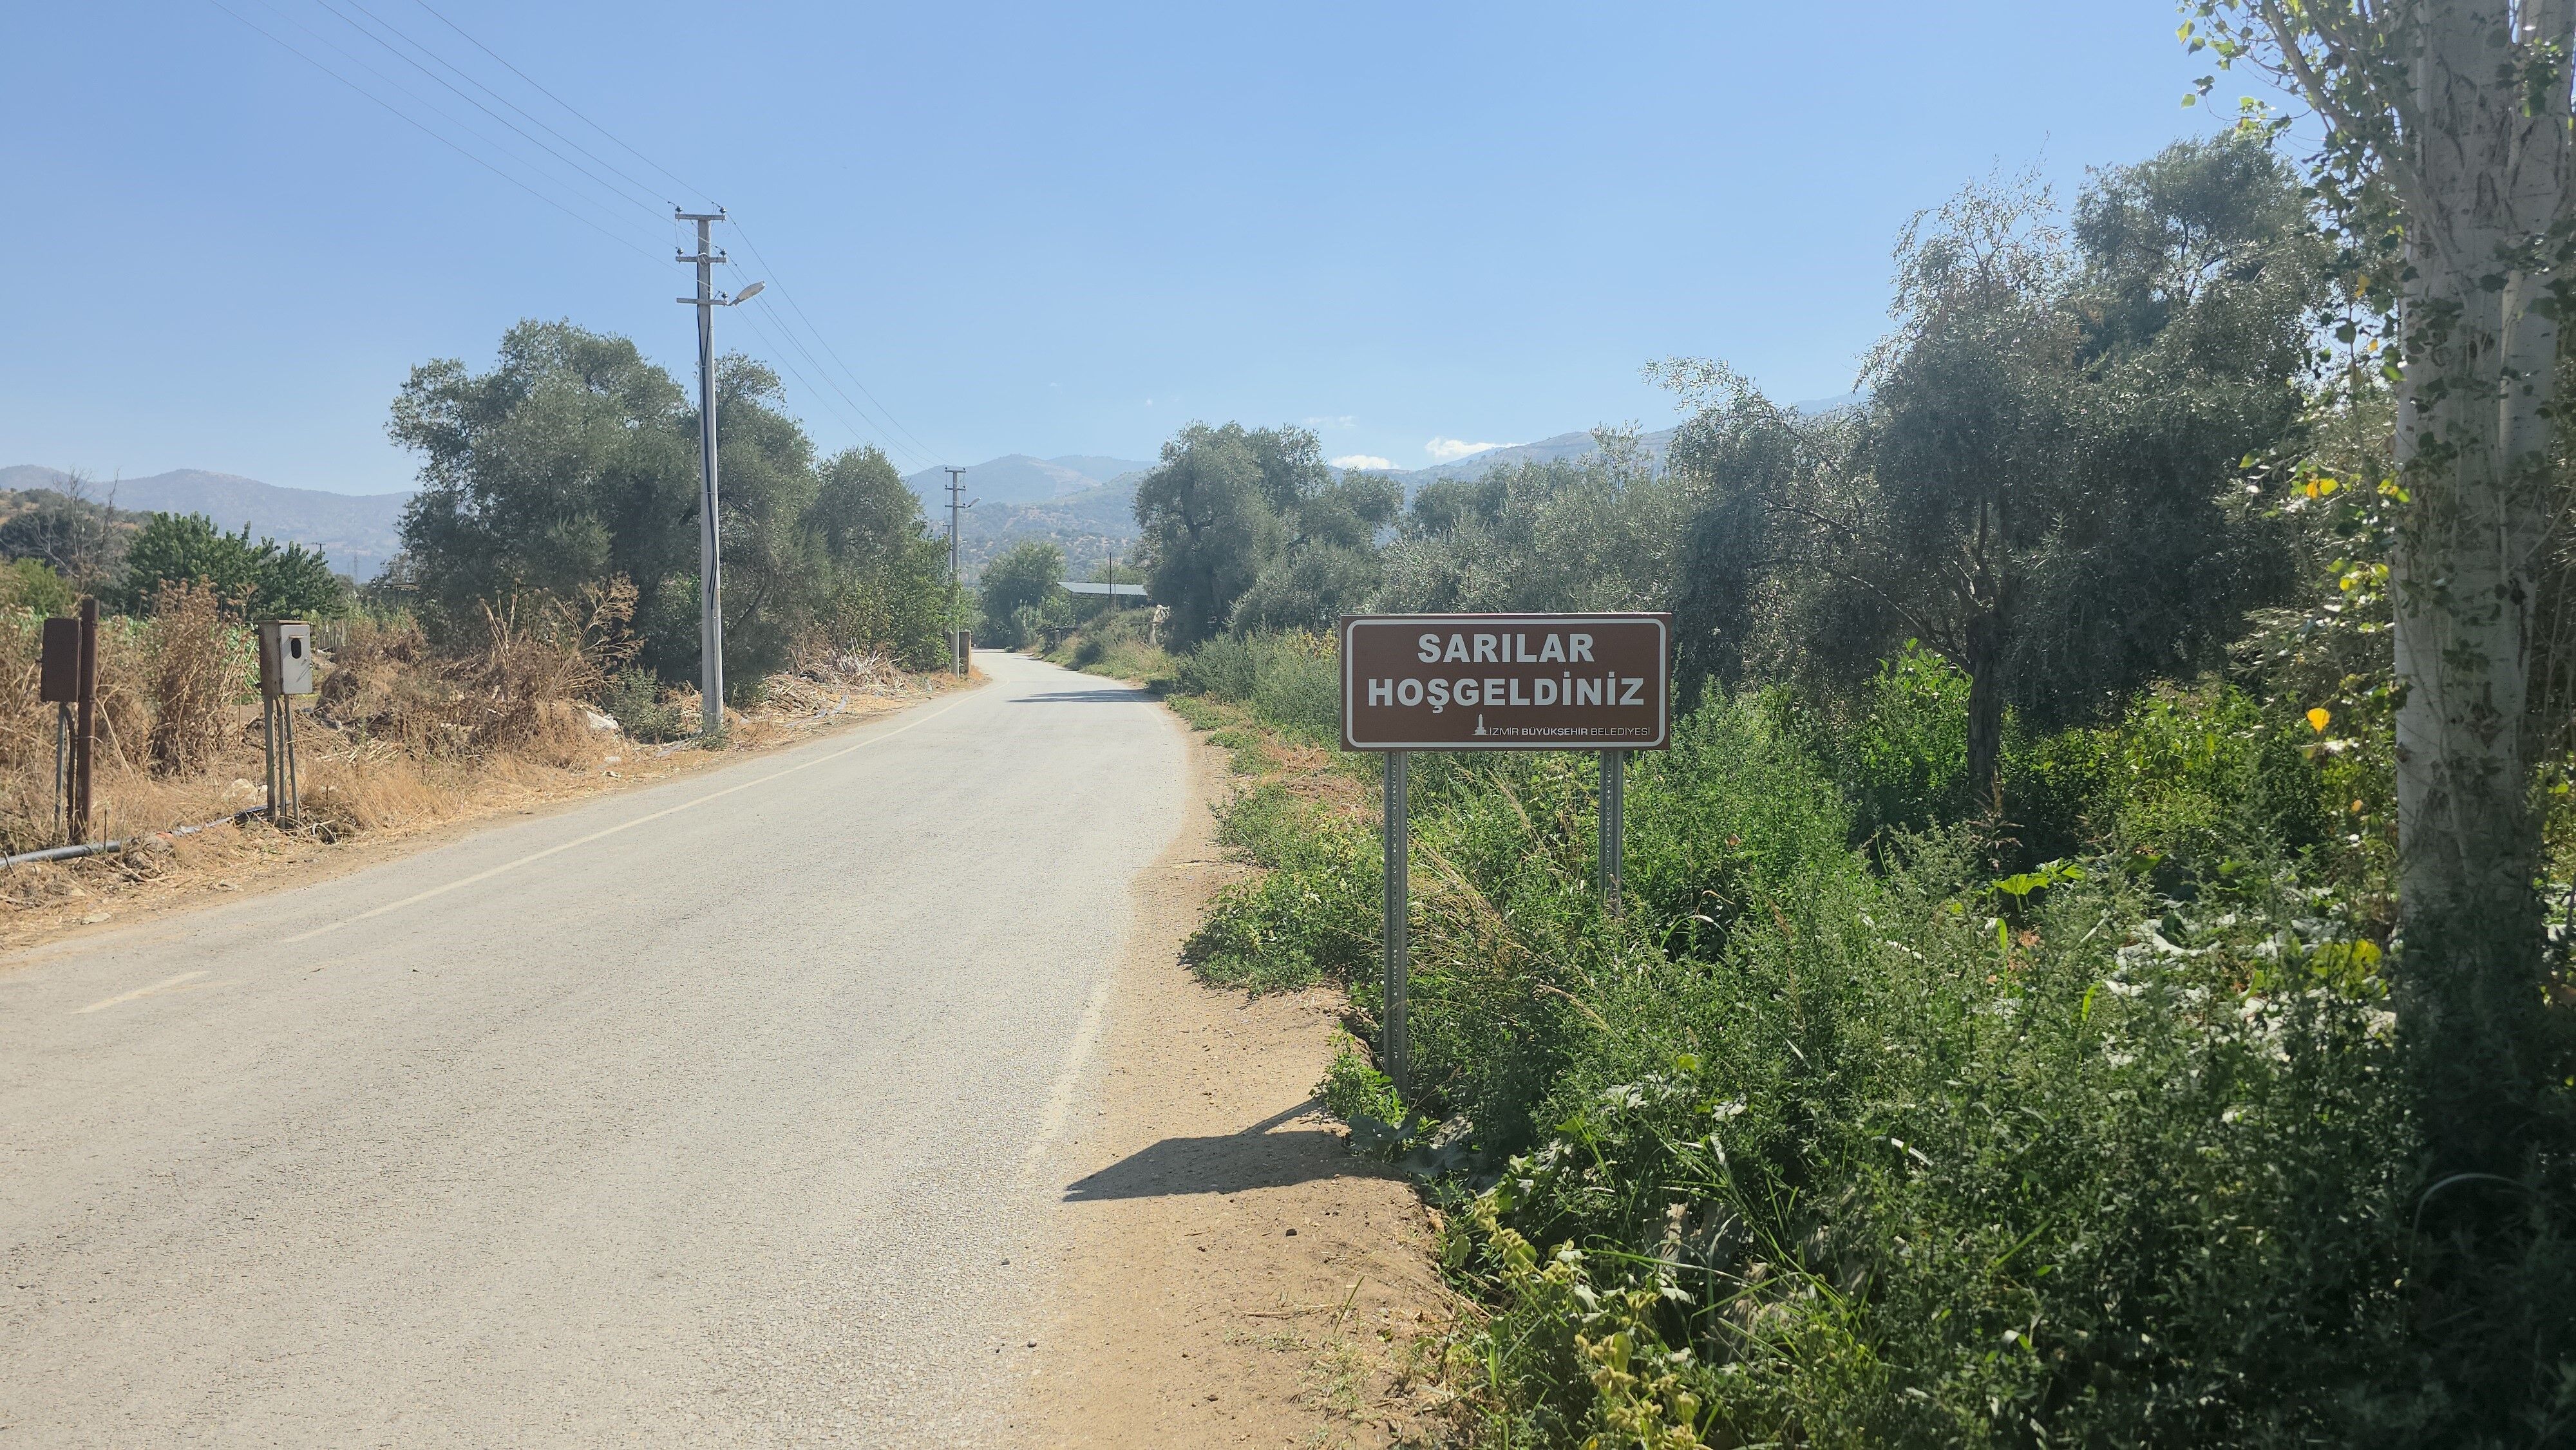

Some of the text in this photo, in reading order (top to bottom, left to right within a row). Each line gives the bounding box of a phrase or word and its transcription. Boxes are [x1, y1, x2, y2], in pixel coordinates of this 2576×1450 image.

[1417, 634, 1595, 663] SARILAR
[1368, 671, 1645, 713] HOŞGELDİNİZ
[1490, 726, 1650, 736] İZMİR BÜYÜKŞEHİR BELEDİYESİ
